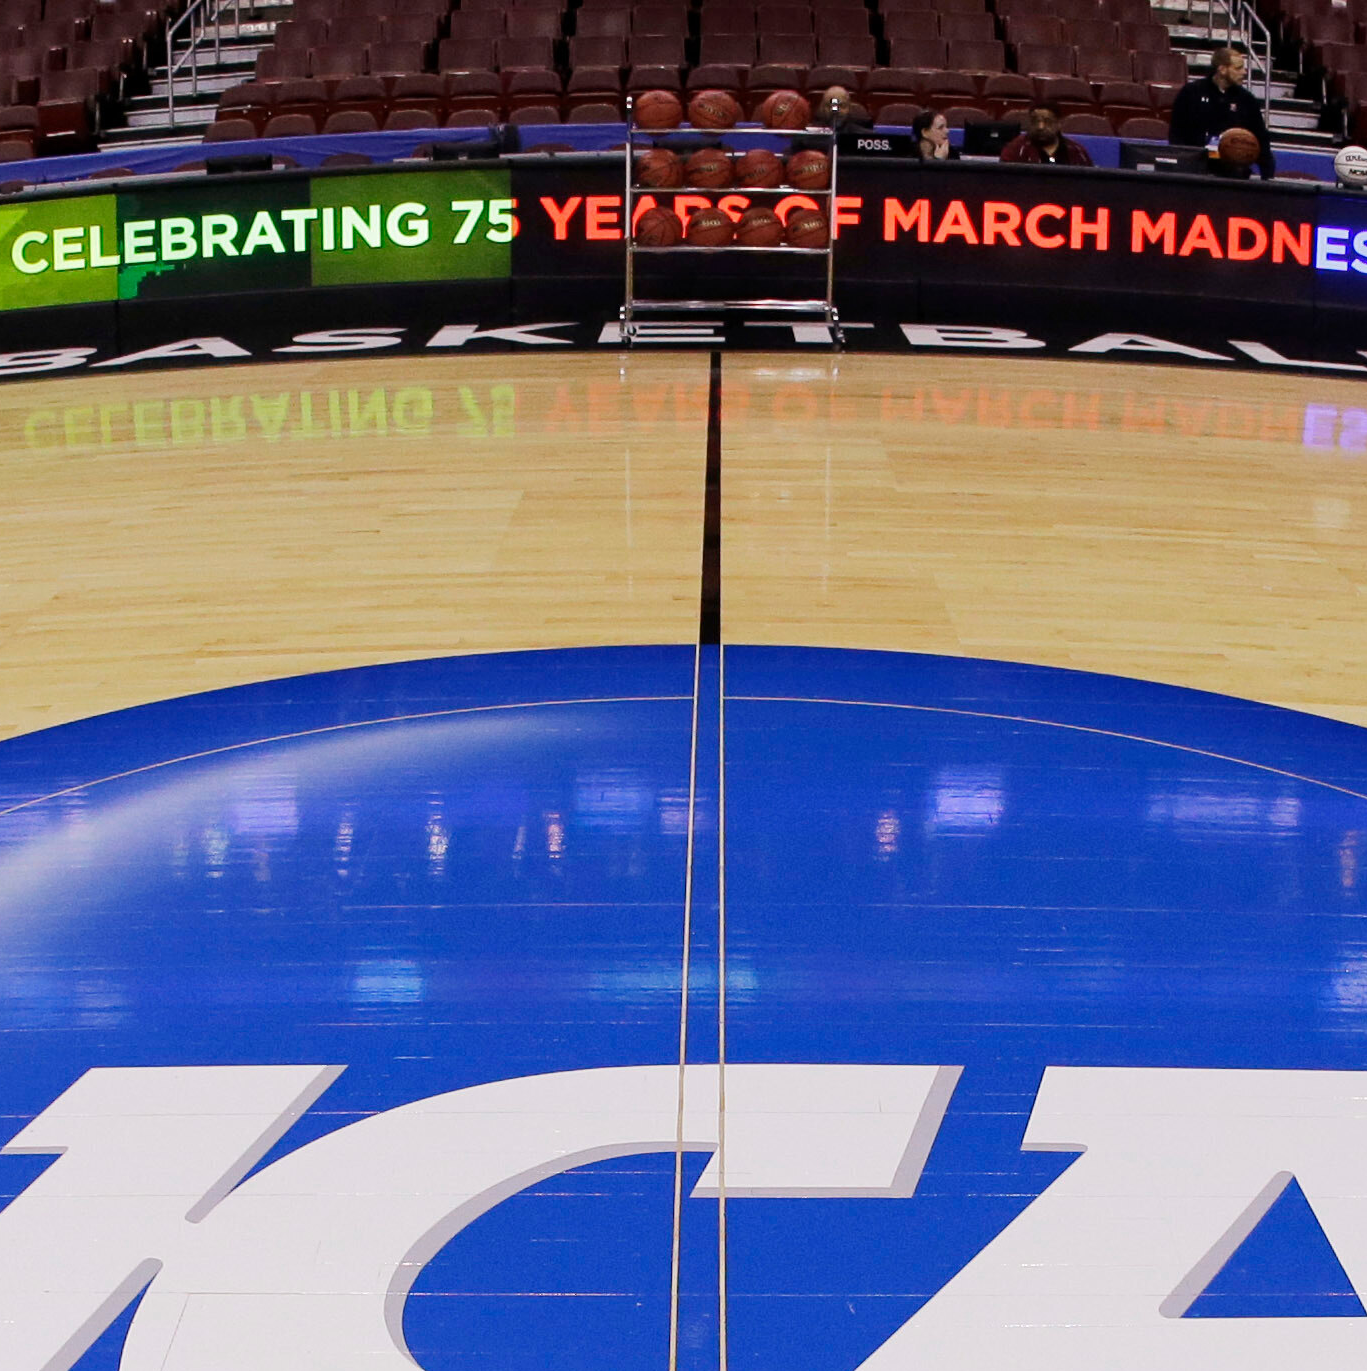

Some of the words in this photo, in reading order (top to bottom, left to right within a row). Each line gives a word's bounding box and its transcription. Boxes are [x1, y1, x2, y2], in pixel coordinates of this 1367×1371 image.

[857, 138, 892, 151] POSS.
[11, 202, 430, 274] CELEBRATING
[451, 198, 521, 244] 75
[883, 197, 1110, 251] MARCH
